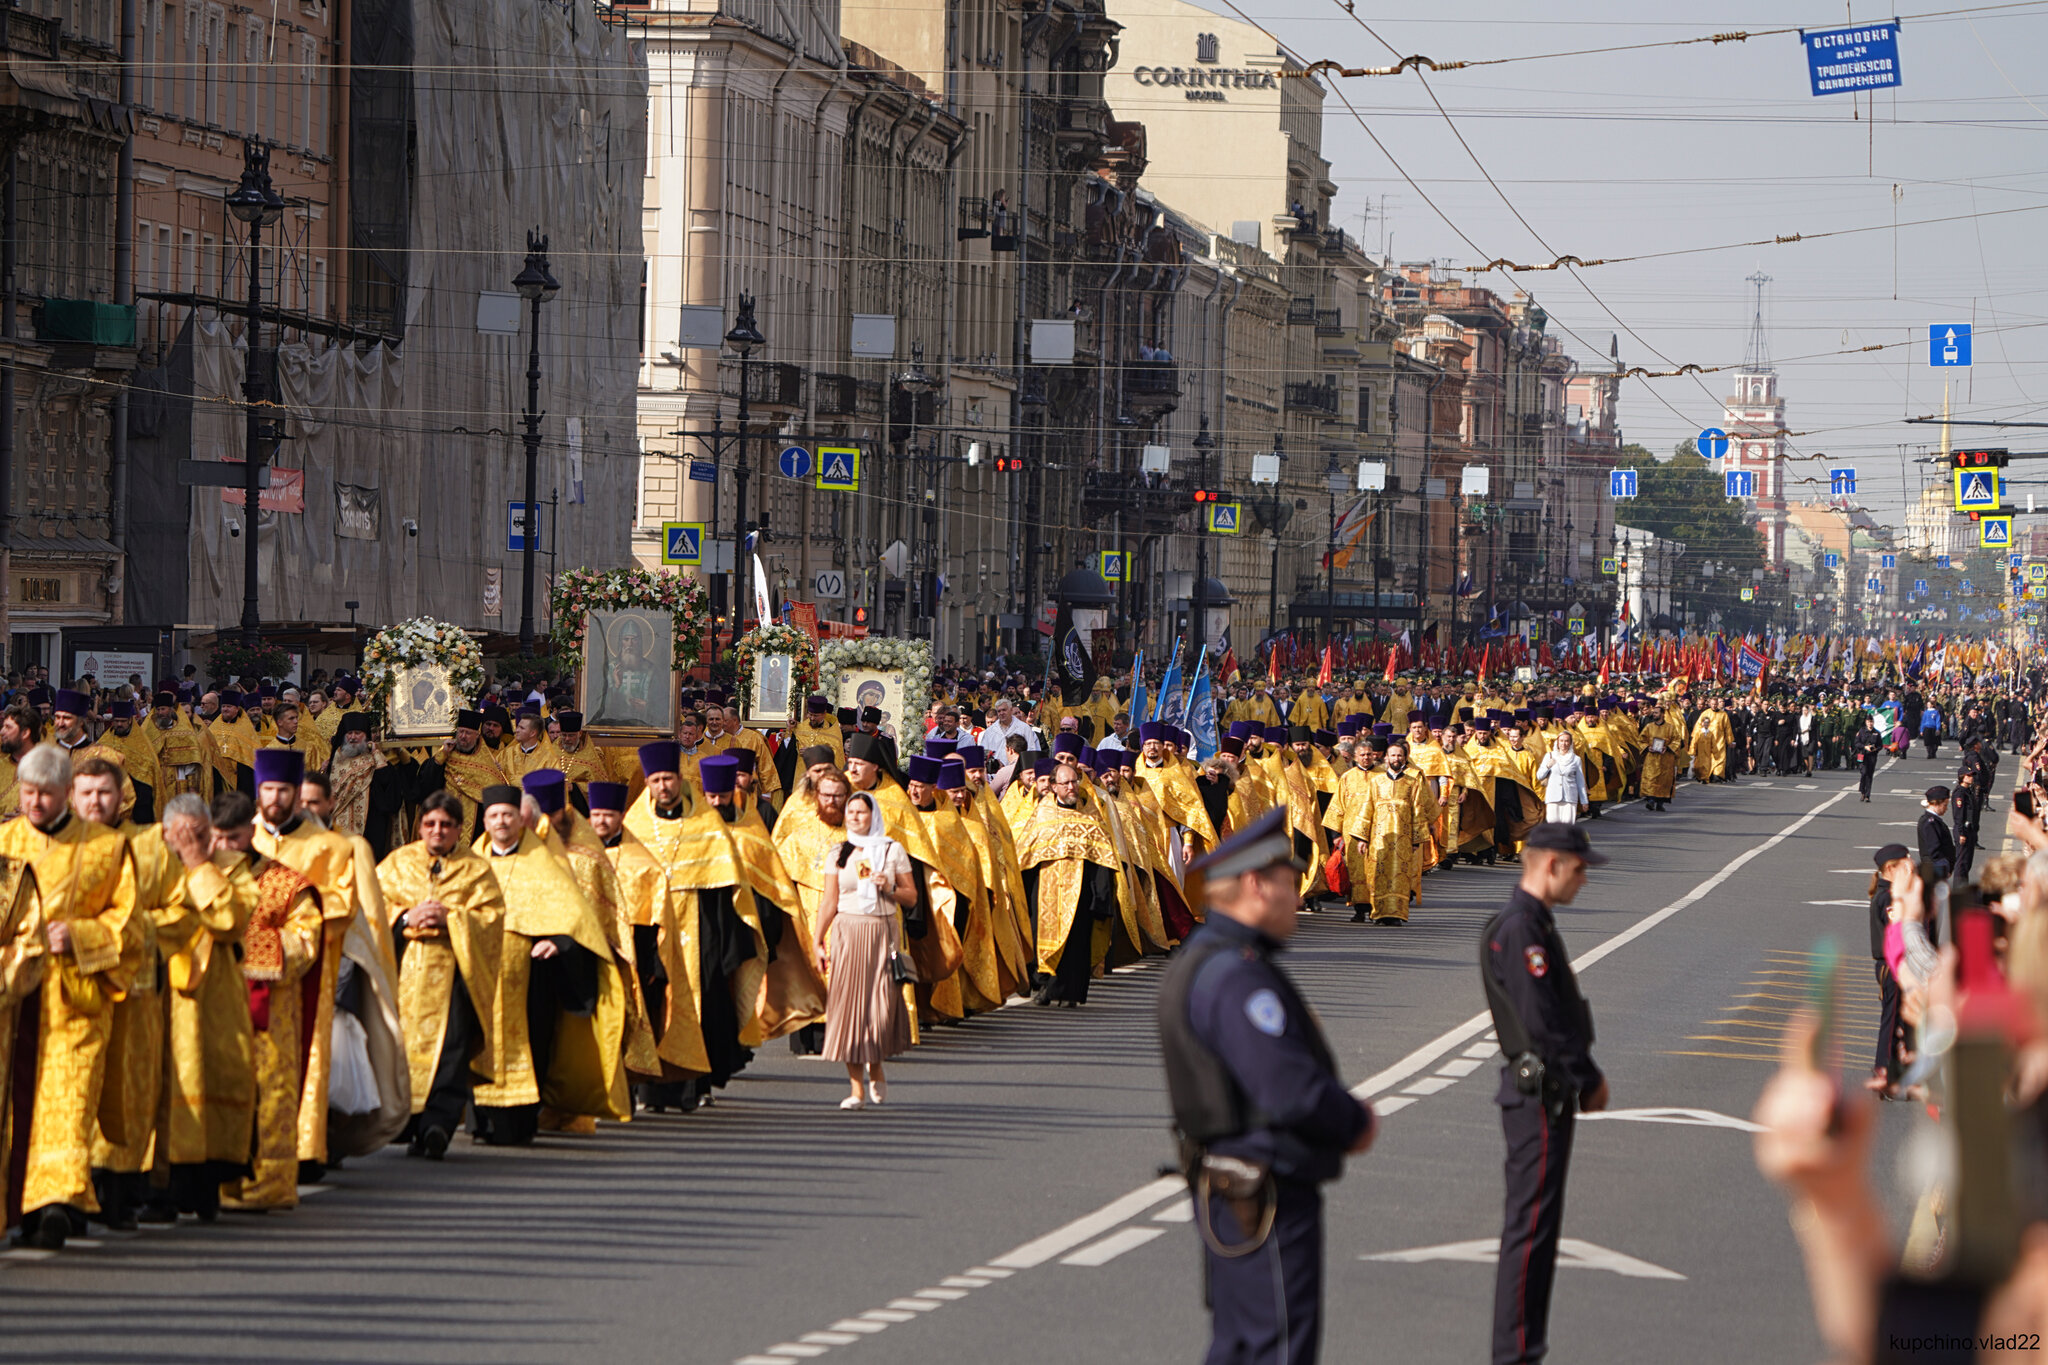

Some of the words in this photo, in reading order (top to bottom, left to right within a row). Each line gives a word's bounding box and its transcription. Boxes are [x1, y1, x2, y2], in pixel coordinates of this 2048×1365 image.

[1814, 29, 1888, 48] ОСТАНОВКА
[1133, 65, 1277, 89] CORINTHIA
[1816, 59, 1892, 78] ТРОЛЛЕЙБУСОВ
[1818, 72, 1894, 90] ОДНОВРЕМЕННО
[1185, 90, 1226, 101] HOTEL
[1011, 459, 1022, 470] 07
[1975, 452, 1988, 464] 07
